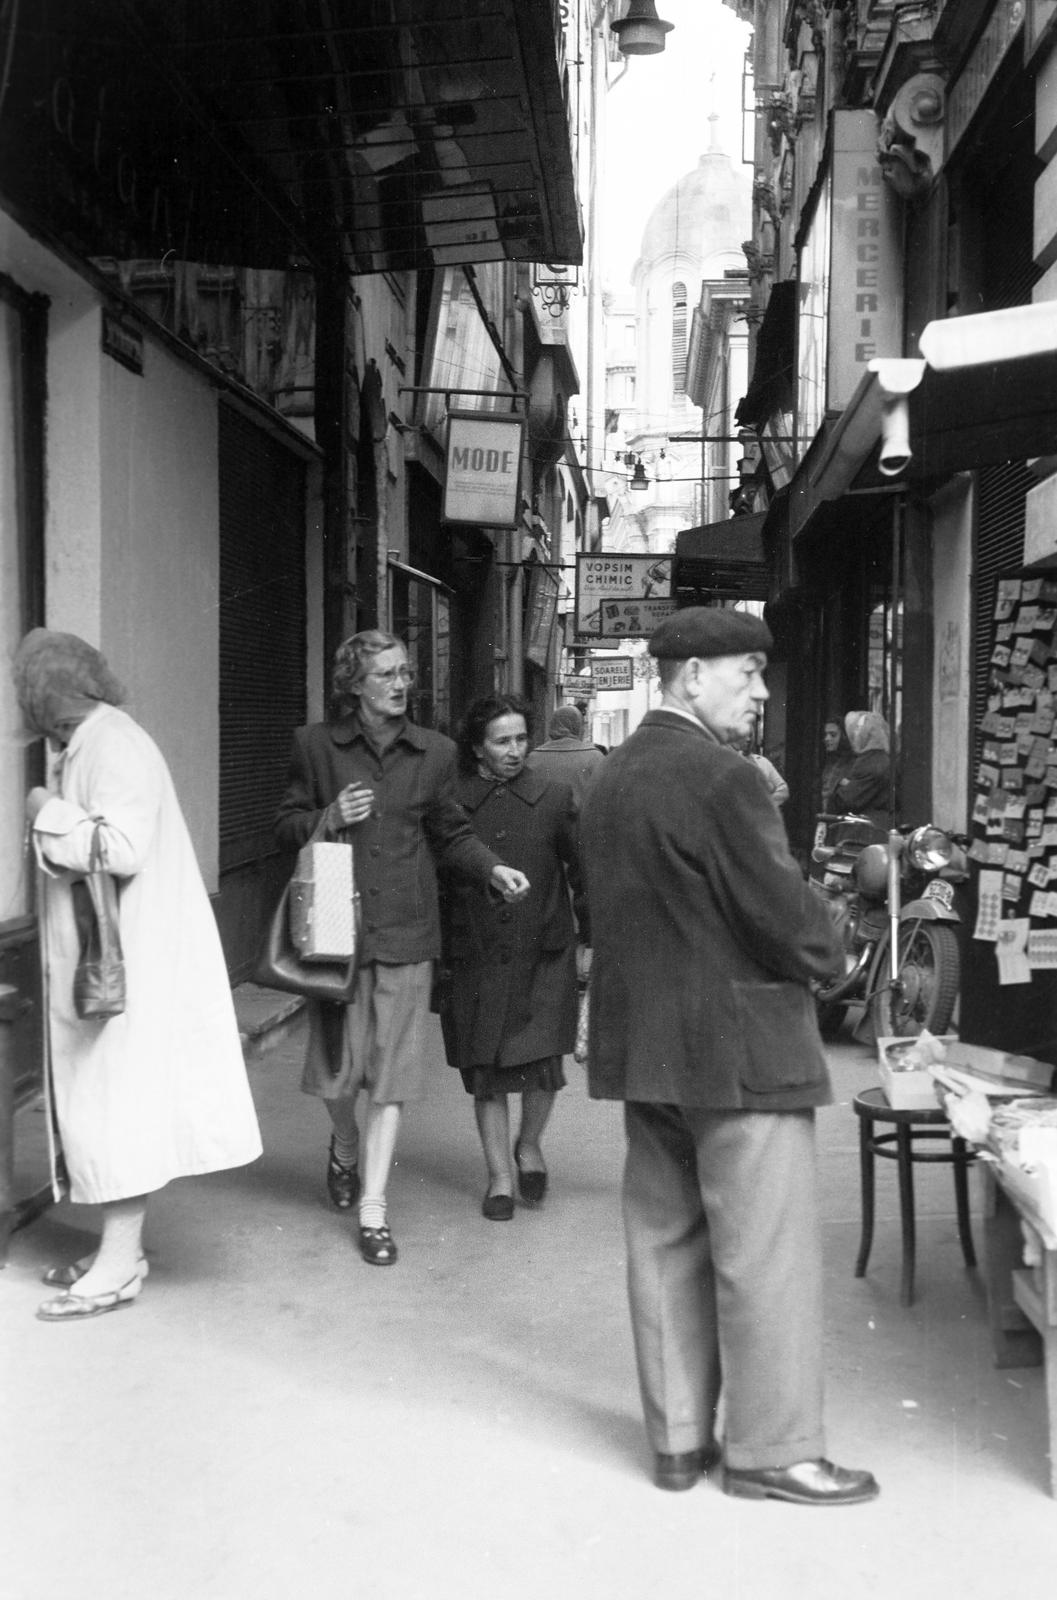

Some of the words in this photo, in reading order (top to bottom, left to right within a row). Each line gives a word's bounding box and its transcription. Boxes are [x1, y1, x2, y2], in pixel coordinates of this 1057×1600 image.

[856, 167, 881, 362] MERCERIE
[452, 447, 514, 473] MODE
[586, 562, 633, 573] VOPSIM
[586, 575, 632, 585] CHIMIC
[598, 676, 631, 687] ENJERIE
